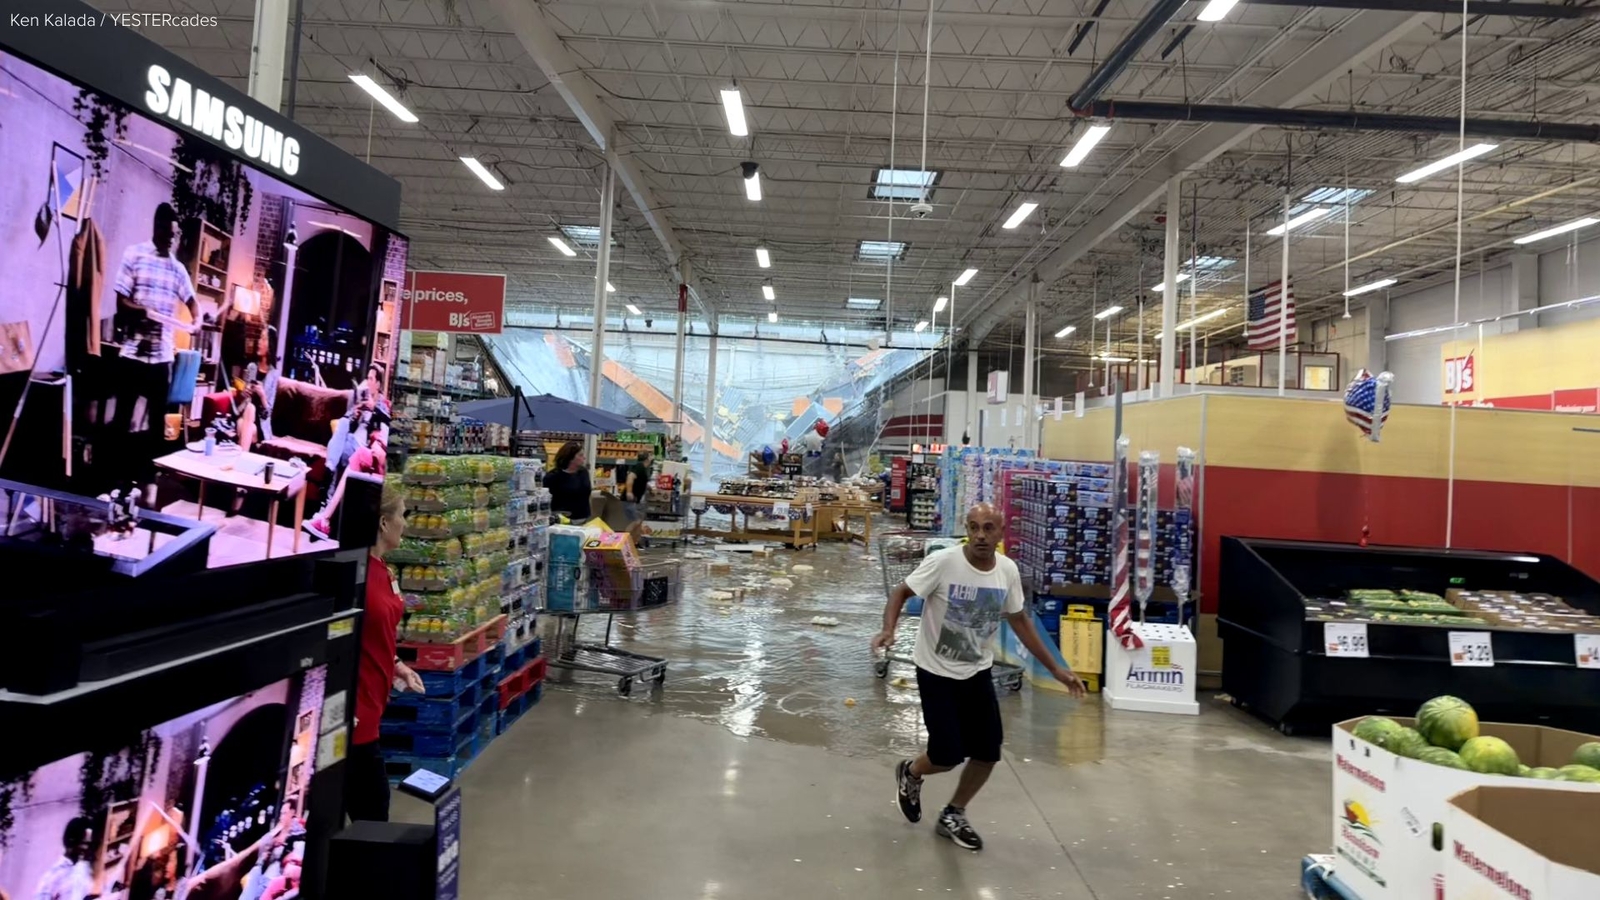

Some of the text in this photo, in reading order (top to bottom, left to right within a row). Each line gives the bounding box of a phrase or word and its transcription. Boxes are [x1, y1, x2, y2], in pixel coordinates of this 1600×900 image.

[145, 64, 301, 176] SAMSUNG
[414, 287, 469, 305] prices,
[449, 311, 471, 328] BJ's
[951, 584, 978, 601] AERO
[1126, 661, 1183, 684] Annin
[1453, 839, 1532, 900] Watermelons
